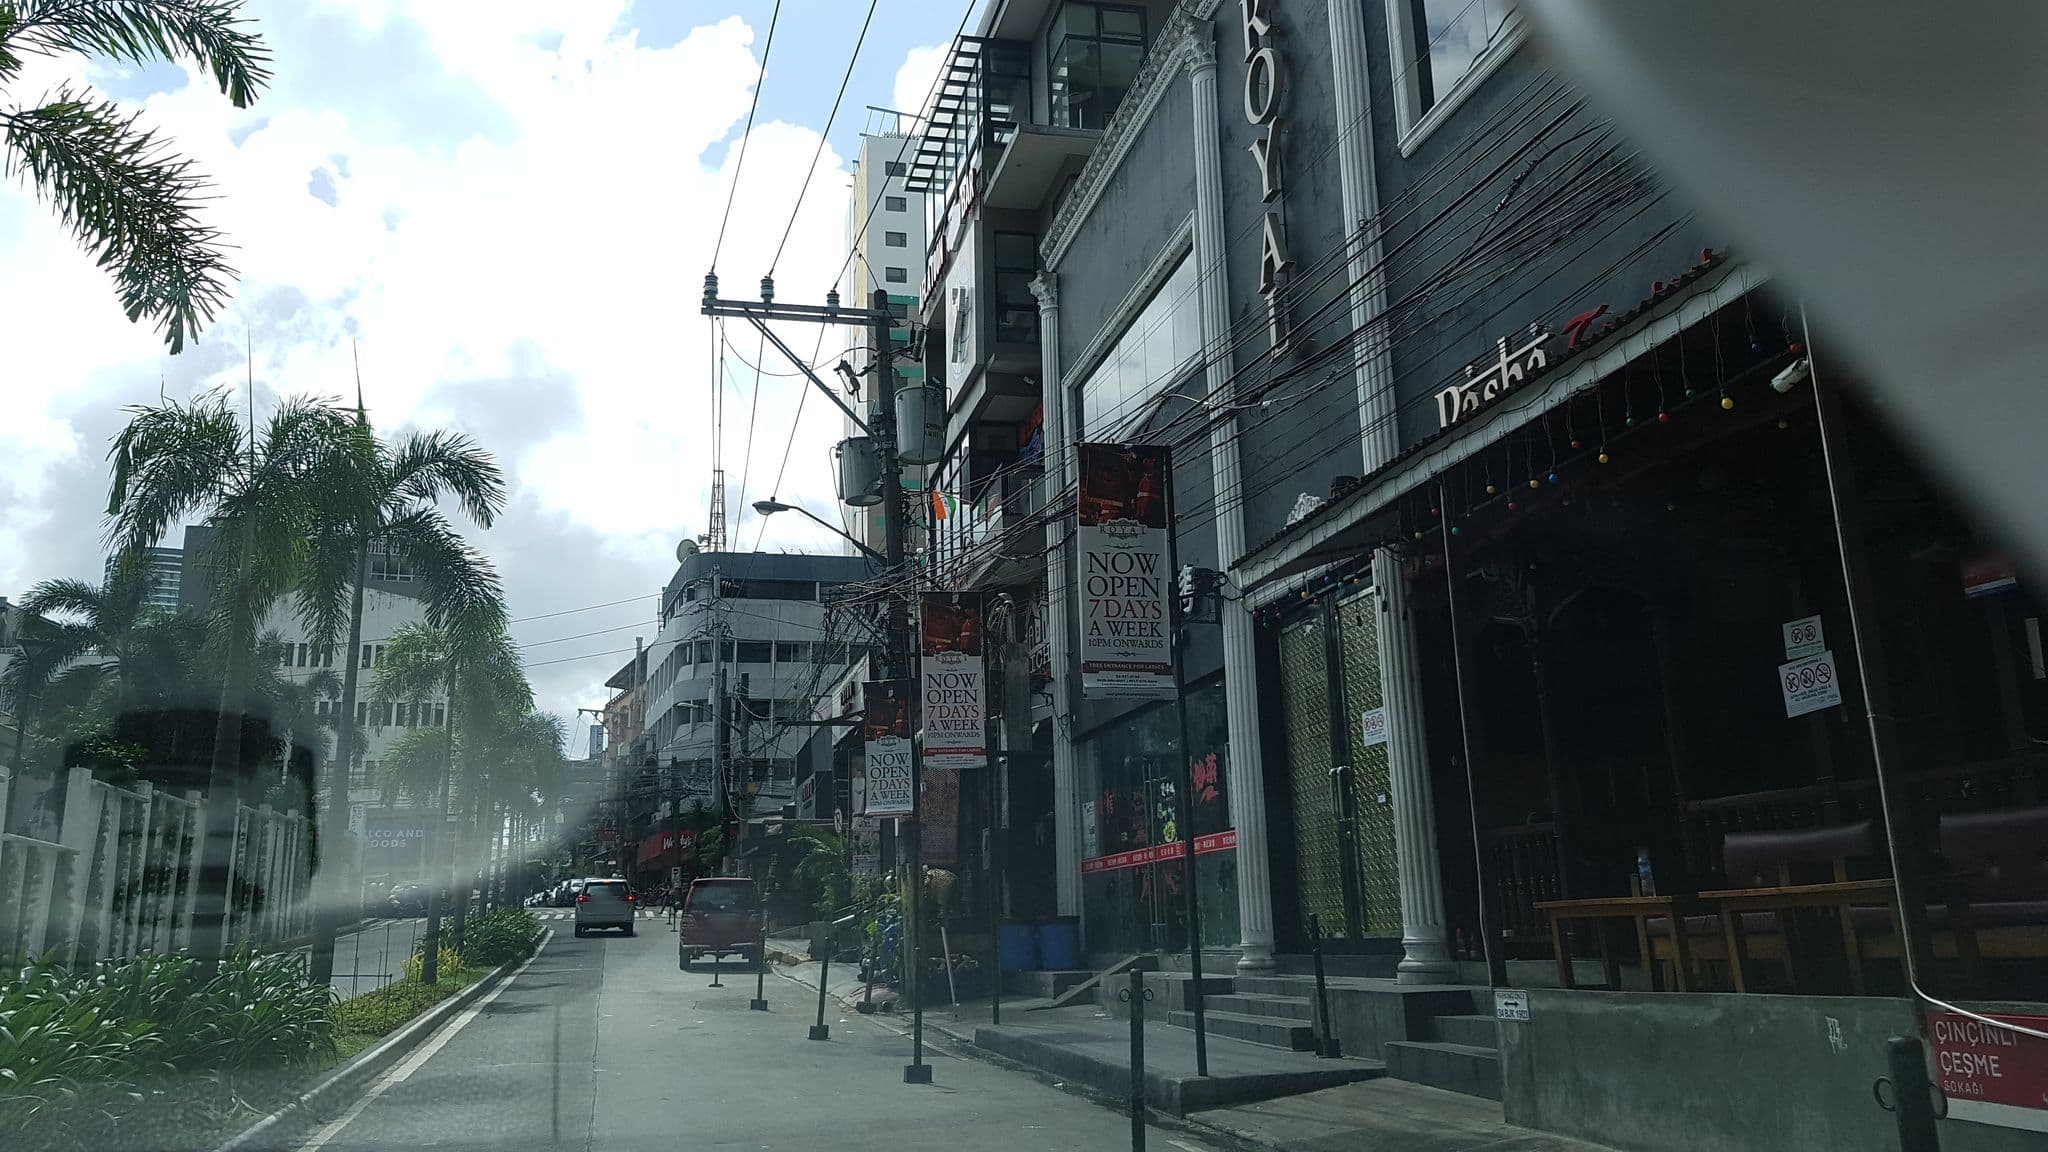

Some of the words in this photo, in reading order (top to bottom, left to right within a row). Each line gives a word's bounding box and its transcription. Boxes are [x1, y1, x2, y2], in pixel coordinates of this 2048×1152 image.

[1240, 0, 1295, 356] ROYAL
[1086, 552, 1160, 575] NOW
[1088, 576, 1160, 598] OPEN
[1089, 600, 1100, 618] 7
[1104, 600, 1162, 620] DAYS
[1088, 620, 1102, 636] A
[1106, 620, 1164, 638] WEEK
[1088, 638, 1110, 647] 10PM
[1113, 639, 1163, 649] ONWARDS
[927, 673, 977, 689] NOW
[927, 690, 977, 704] OPEN
[928, 705, 936, 718] 7
[939, 705, 979, 718] DAYS
[928, 720, 936, 730] A
[940, 720, 979, 730] WEEK
[870, 753, 909, 766] NOW
[871, 766, 909, 779] OPEN
[871, 780, 877, 790] 7
[880, 779, 910, 790] DAYS
[871, 791, 878, 800] A
[881, 790, 910, 799] WEEK
[1940, 1051, 2002, 1078] ÇEŞME
[1943, 1079, 1984, 1095] SOKAĞI
